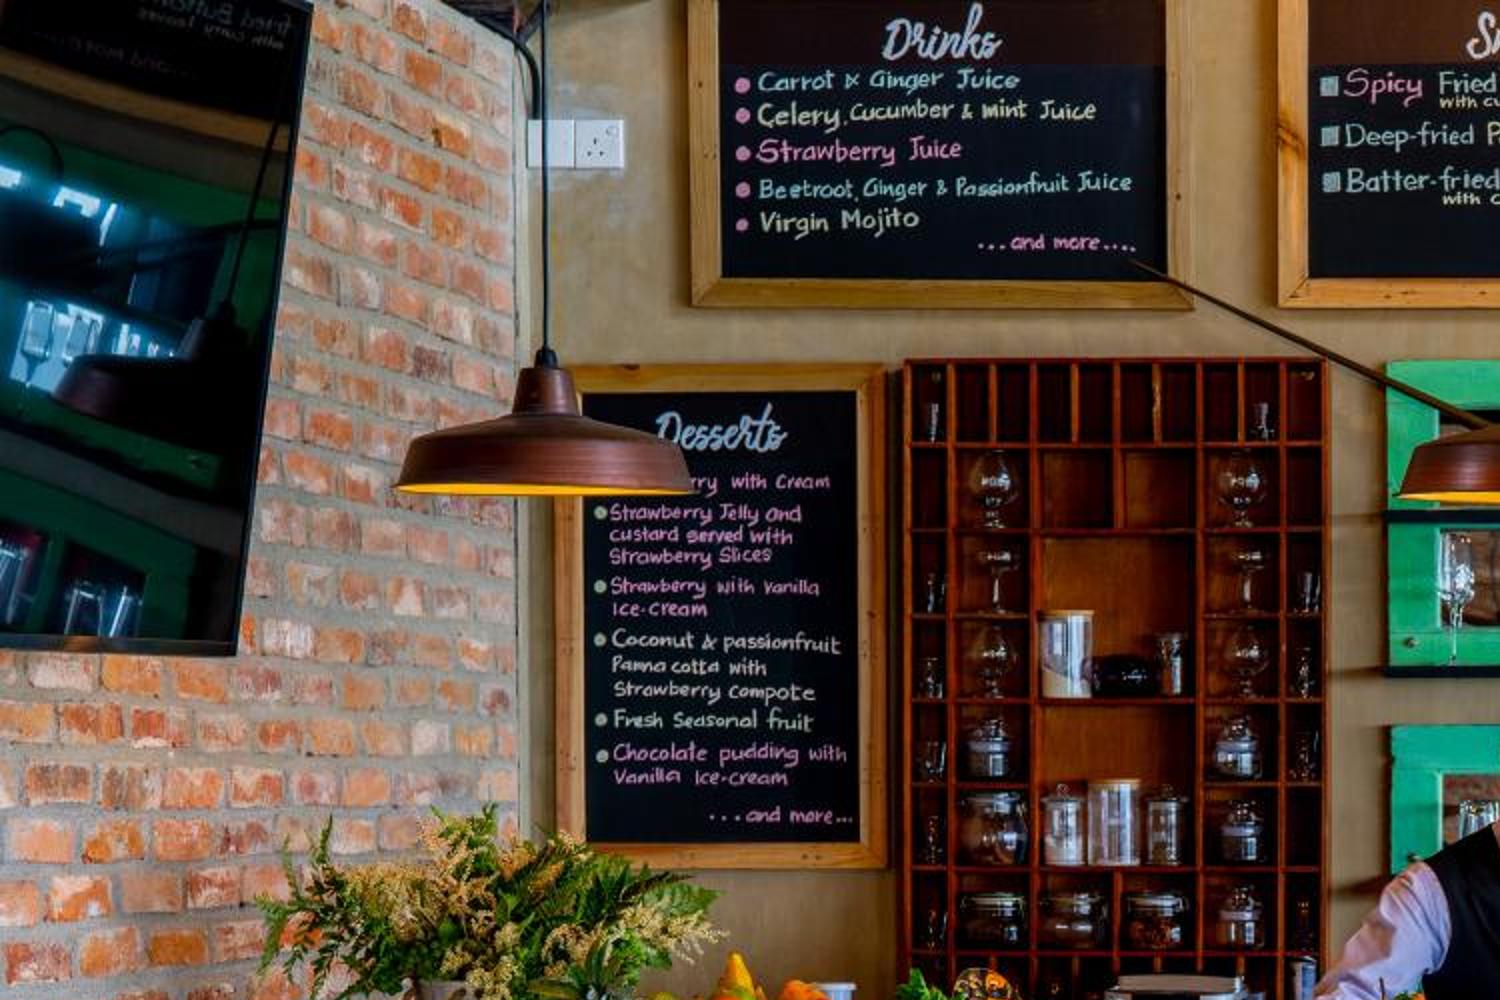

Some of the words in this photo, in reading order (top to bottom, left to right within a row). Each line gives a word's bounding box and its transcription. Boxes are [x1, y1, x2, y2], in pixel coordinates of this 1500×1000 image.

[881, 2, 1002, 61] Drinks
[757, 69, 836, 92] Carrot
[869, 69, 944, 95] Ginger
[956, 67, 1021, 90] Juice
[1343, 68, 1424, 108] Spicy
[1438, 71, 1498, 95] Fried
[850, 99, 954, 122] Cucumber
[1039, 99, 1098, 120] Juice
[1439, 95, 1479, 109] with
[756, 138, 896, 167] Strawberry
[908, 135, 963, 161] Juice
[1345, 122, 1475, 153] Deep-fried
[863, 177, 928, 202] Ginger
[936, 179, 948, 196] &
[955, 171, 1070, 197] Passionfruit
[1077, 171, 1134, 193] Juice
[1345, 164, 1500, 194] Batter-fried
[1442, 190, 1482, 207] with
[760, 209, 830, 241] Virgin
[841, 207, 921, 238] Mojito
[656, 402, 788, 452] Desserts
[731, 471, 768, 491] with
[609, 503, 713, 523] Strawberry
[720, 503, 760, 524] Jelly
[765, 505, 802, 522] and
[609, 526, 680, 543] custard
[686, 521, 744, 544] served
[749, 527, 793, 546] with
[609, 547, 713, 571] Strawberry
[719, 546, 773, 563] Slices
[610, 576, 707, 600] Strawberry
[717, 576, 755, 595] with
[611, 628, 695, 649] Coconut
[723, 631, 842, 656] passionfruit
[611, 655, 667, 674] Panna
[671, 659, 720, 675] cotta
[729, 657, 767, 676] with
[613, 680, 721, 706] Strawberry
[613, 708, 664, 729] Fresh
[766, 705, 814, 732] fruit
[613, 741, 708, 762] Chocolate
[718, 741, 800, 768] pudding
[808, 744, 848, 763] with
[613, 766, 682, 785] Vanilla
